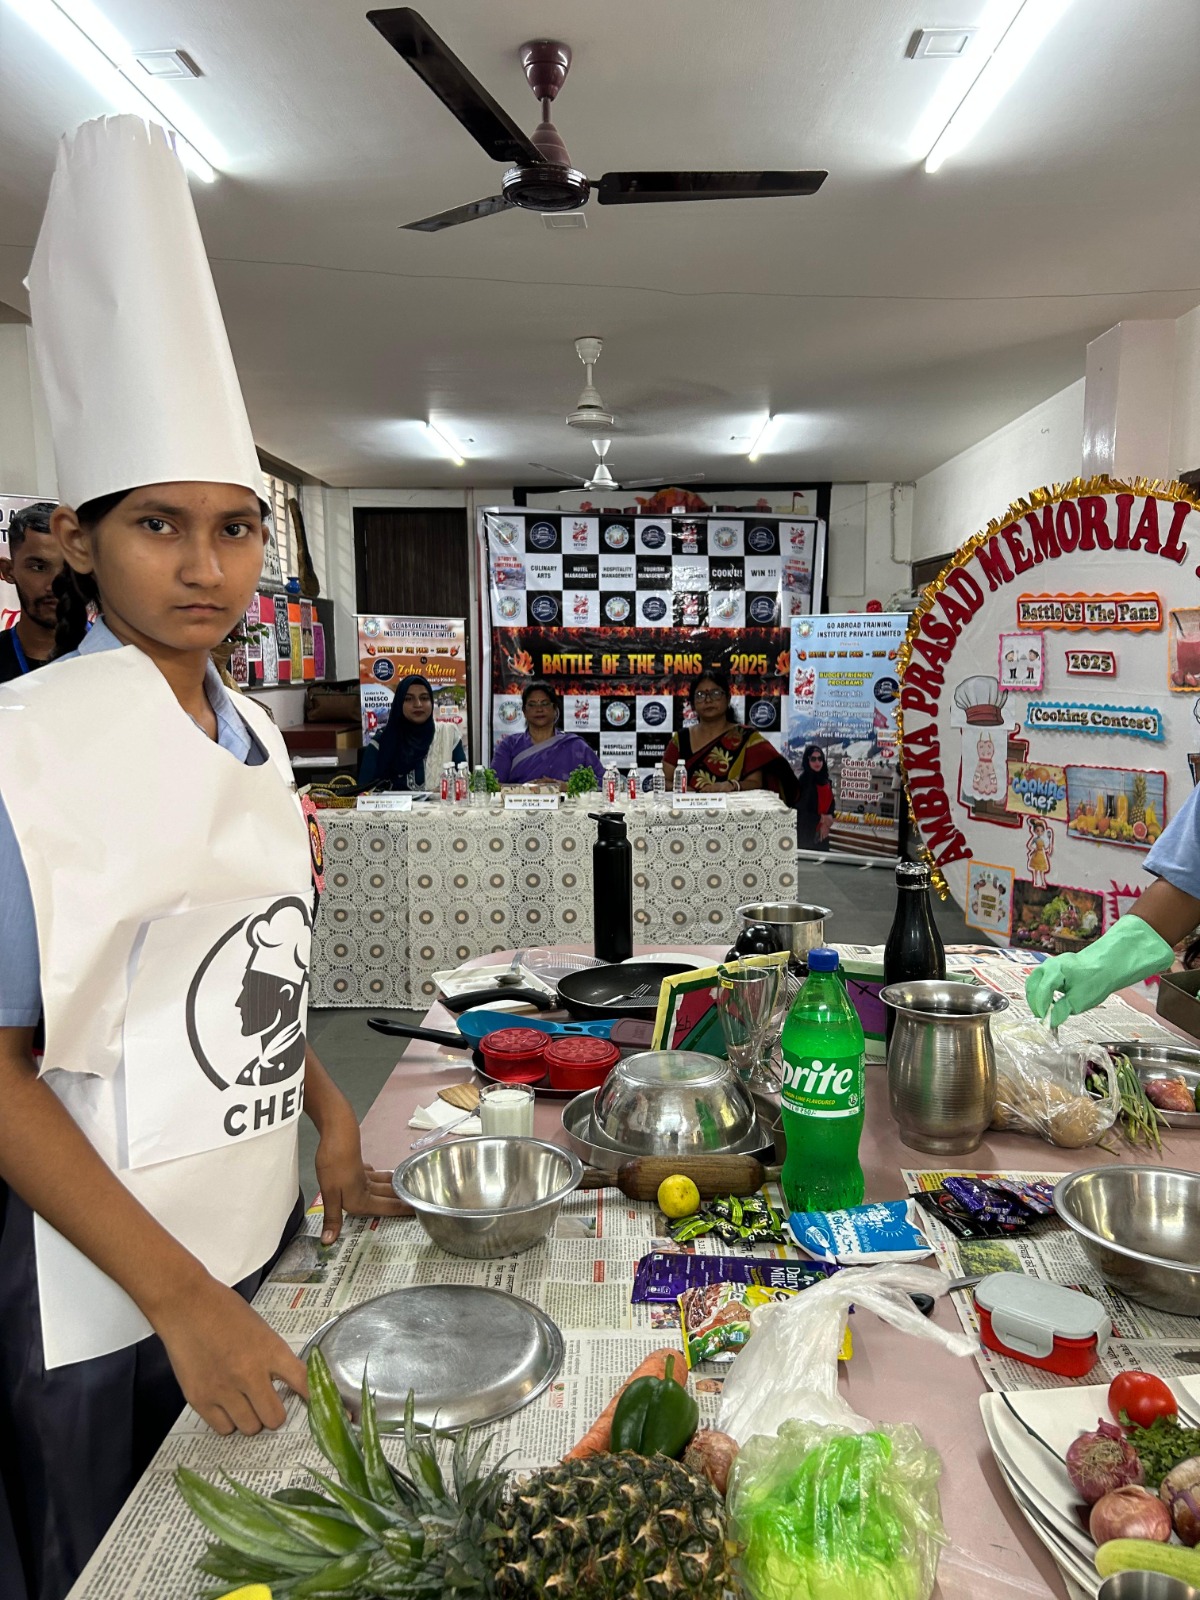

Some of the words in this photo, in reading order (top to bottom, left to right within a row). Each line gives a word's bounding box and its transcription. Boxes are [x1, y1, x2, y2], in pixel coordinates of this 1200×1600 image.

[975, 494, 1192, 592] MEMORIAL
[712, 568, 732, 577] COOK
[751, 569, 766, 577] WIN
[1021, 603, 1062, 622] Battle
[1064, 603, 1082, 622] Of
[1087, 604, 1115, 622] The
[1118, 604, 1157, 622] Pans
[901, 566, 984, 718] PRASAD
[426, 664, 456, 676] Khan
[542, 654, 592, 674] BATTLE
[602, 654, 620, 674] OF
[628, 654, 654, 674] THE
[664, 654, 702, 674] PANS
[730, 654, 768, 674] 2025
[1070, 654, 1112, 672] 2025
[1029, 708, 1088, 726] (Cooking
[1090, 712, 1158, 734] Contest)
[842, 780, 870, 788] Become
[902, 723, 974, 868] AMBIKA
[782, 1060, 853, 1095] prite
[770, 1267, 786, 1288] Milk
[783, 1267, 800, 1290] Dairy
[556, 1392, 564, 1408] NIMS
